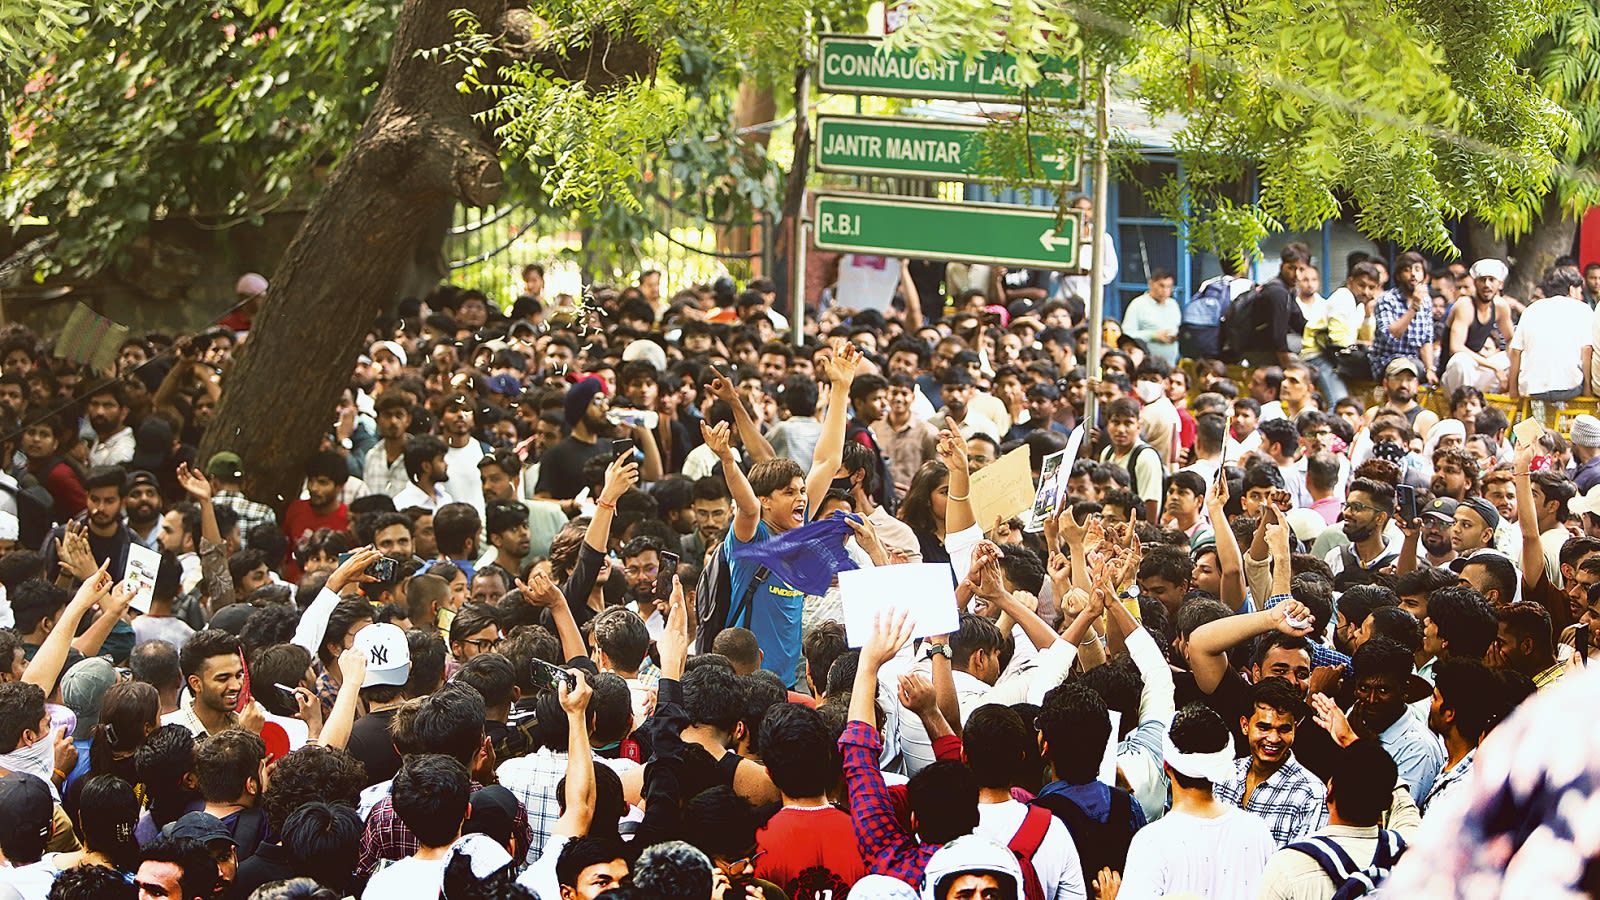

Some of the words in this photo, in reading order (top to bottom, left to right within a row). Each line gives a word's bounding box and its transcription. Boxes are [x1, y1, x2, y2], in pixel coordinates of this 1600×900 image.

[826, 54, 960, 81] CONNAUGHT
[965, 61, 1025, 88] PLAC
[823, 133, 882, 158] JANTR
[885, 137, 961, 164] MANTAR
[822, 212, 860, 235] R.B.I
[370, 645, 388, 665] NY
